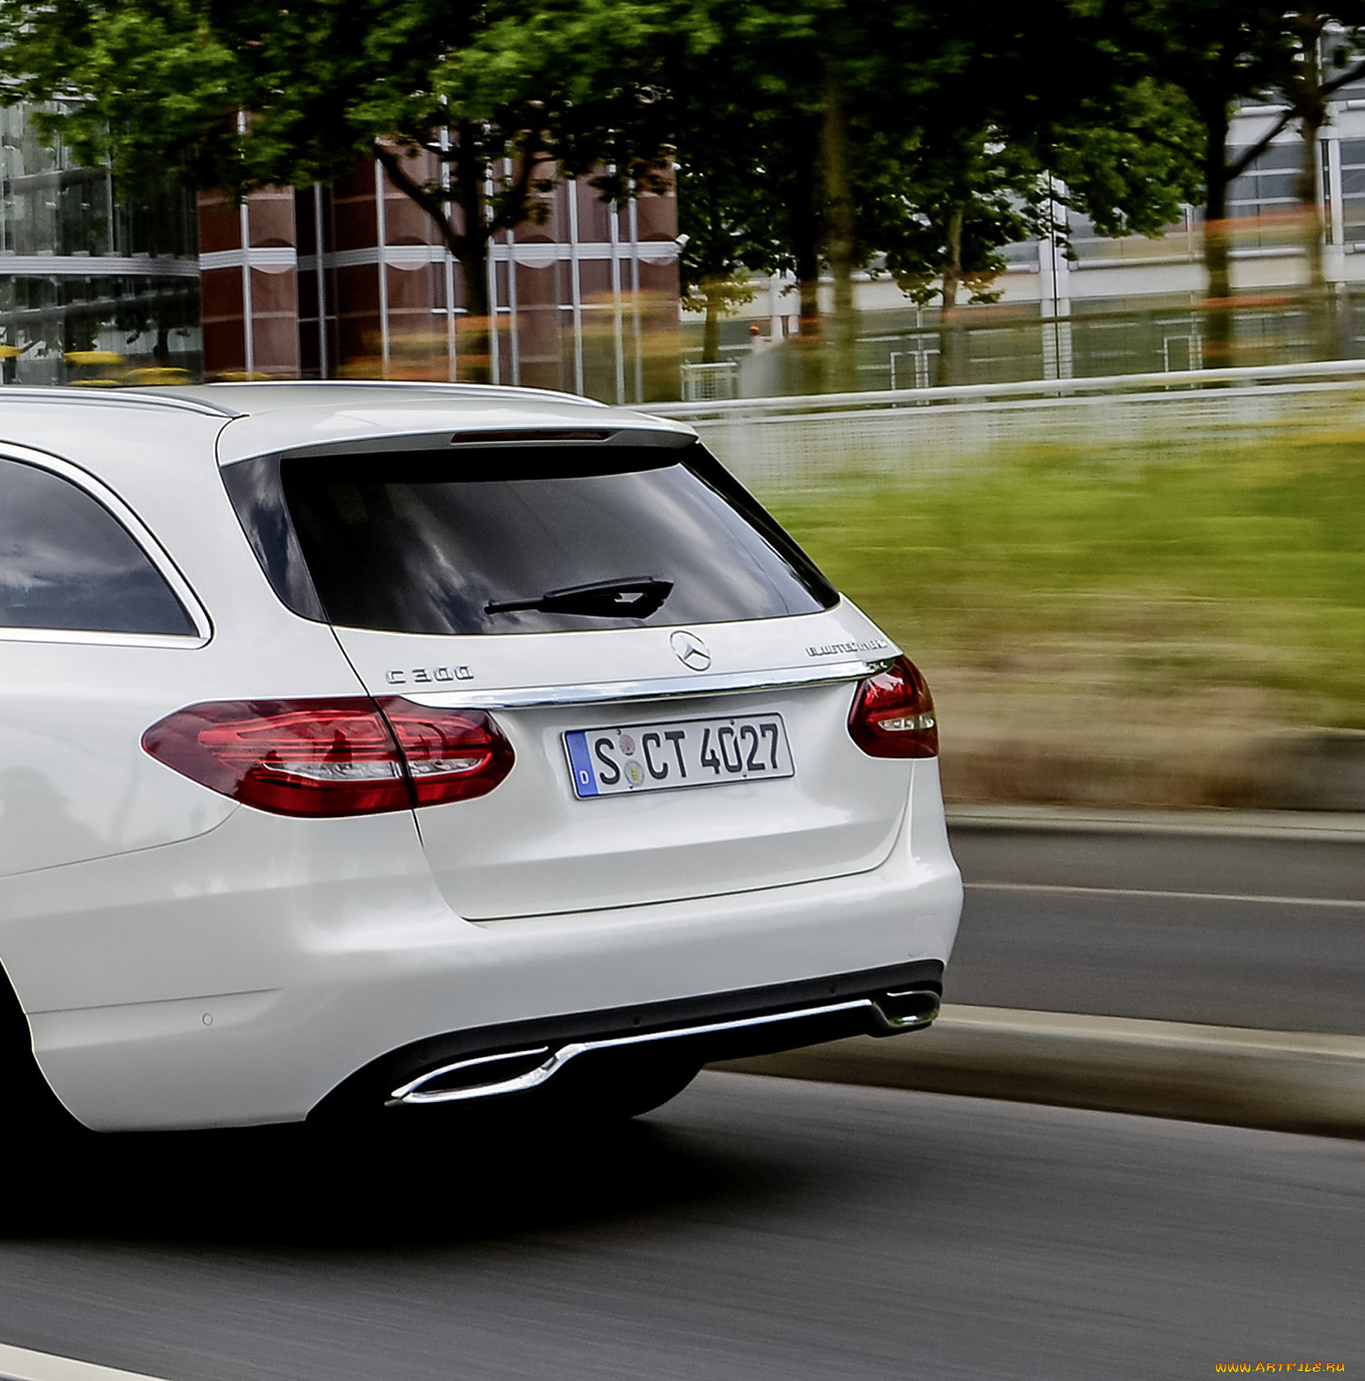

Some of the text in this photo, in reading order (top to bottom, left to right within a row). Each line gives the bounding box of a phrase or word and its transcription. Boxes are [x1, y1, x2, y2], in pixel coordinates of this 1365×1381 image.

[385, 664, 475, 684] C 300
[594, 722, 779, 785] S CT 4027
[579, 770, 590, 785] D
